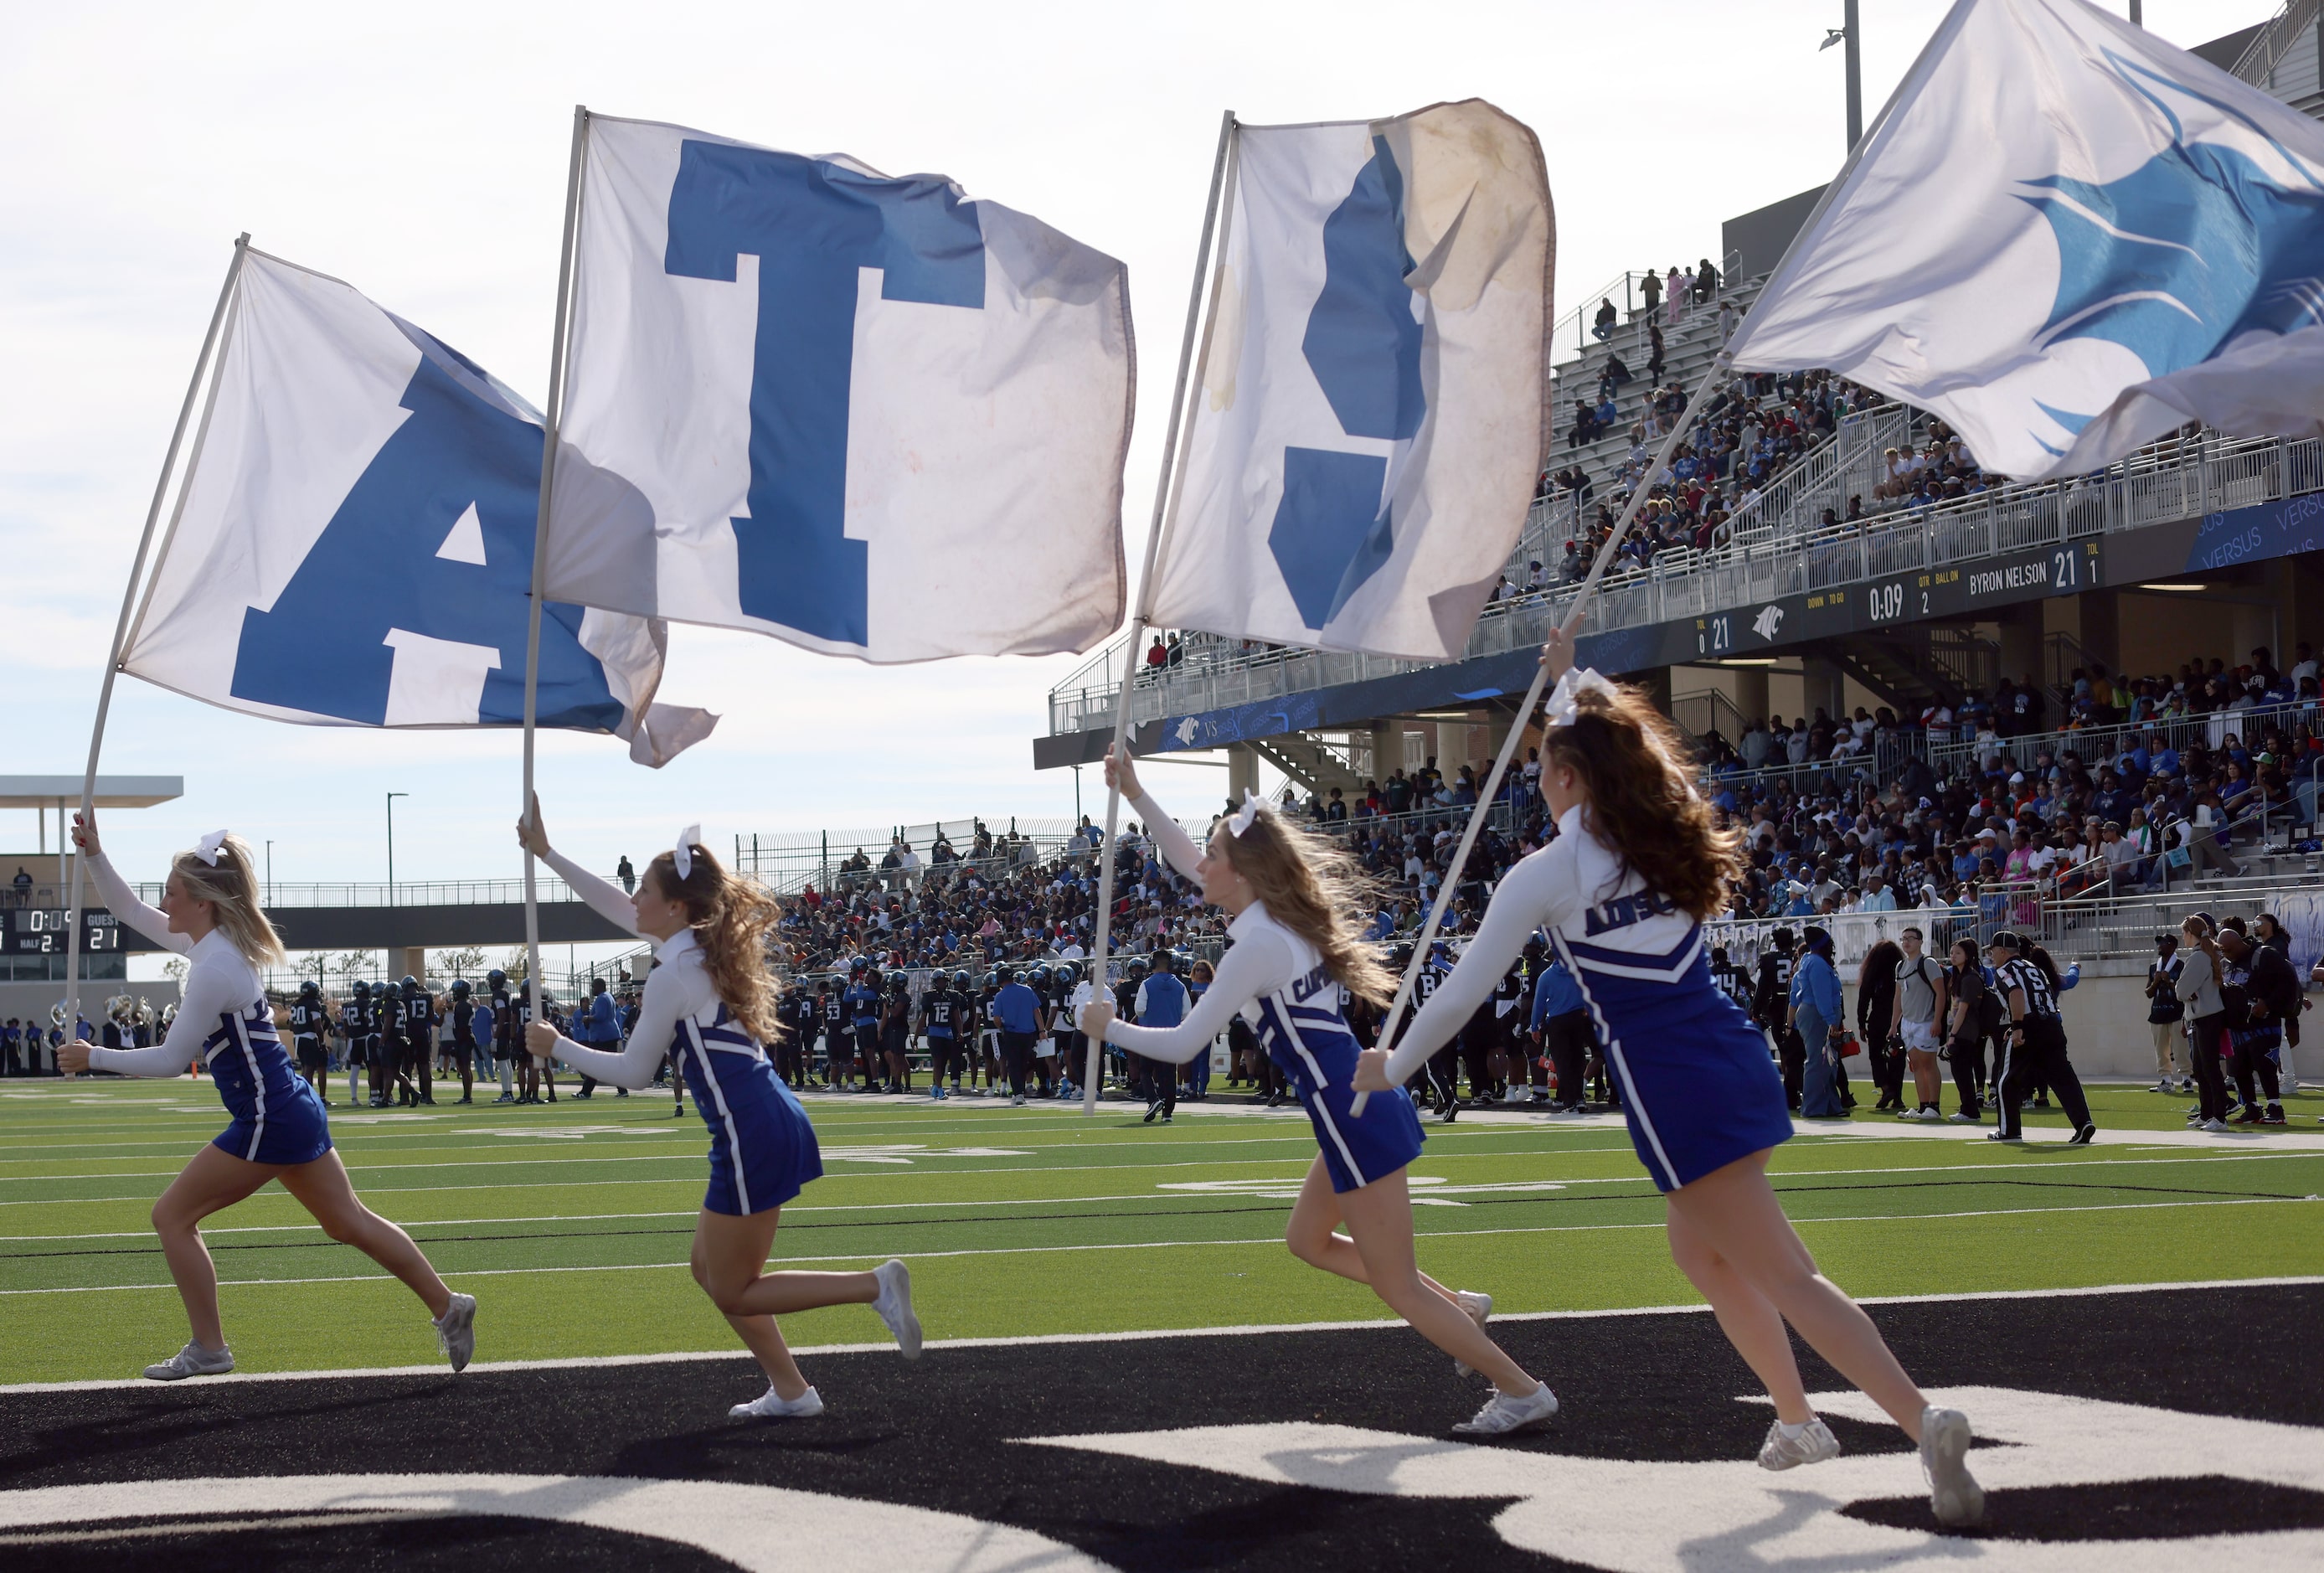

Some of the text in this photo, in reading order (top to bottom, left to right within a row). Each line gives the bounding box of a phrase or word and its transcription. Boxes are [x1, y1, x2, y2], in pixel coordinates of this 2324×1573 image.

[665, 139, 986, 647] T
[230, 353, 625, 734] A
[2086, 543, 2099, 555] TOL
[2202, 526, 2263, 570] VERSUS
[1935, 570, 1959, 585] BALL ON
[2054, 549, 2075, 588] 21
[2090, 560, 2096, 584] 1
[1918, 575, 1930, 588] QTR
[1970, 561, 2047, 596] BYRON NELSON
[1807, 596, 1824, 609] DOWN
[1829, 592, 1844, 605] TO GO
[1869, 583, 1903, 621] 0:09
[1921, 591, 1930, 614] 2
[1696, 620, 1705, 630] TOL
[1713, 616, 1729, 650] 21
[1698, 633, 1705, 653] 0
[1205, 720, 1218, 738] VS
[20, 939, 40, 949] HALF
[42, 935, 52, 952] 2
[90, 928, 118, 949] 21
[1421, 974, 1435, 996] B
[2025, 967, 2045, 990] S
[291, 1006, 307, 1025] 20
[343, 1007, 361, 1026] 42
[411, 1000, 427, 1019] 13
[827, 1004, 841, 1020] 53
[935, 1006, 950, 1023] 12
